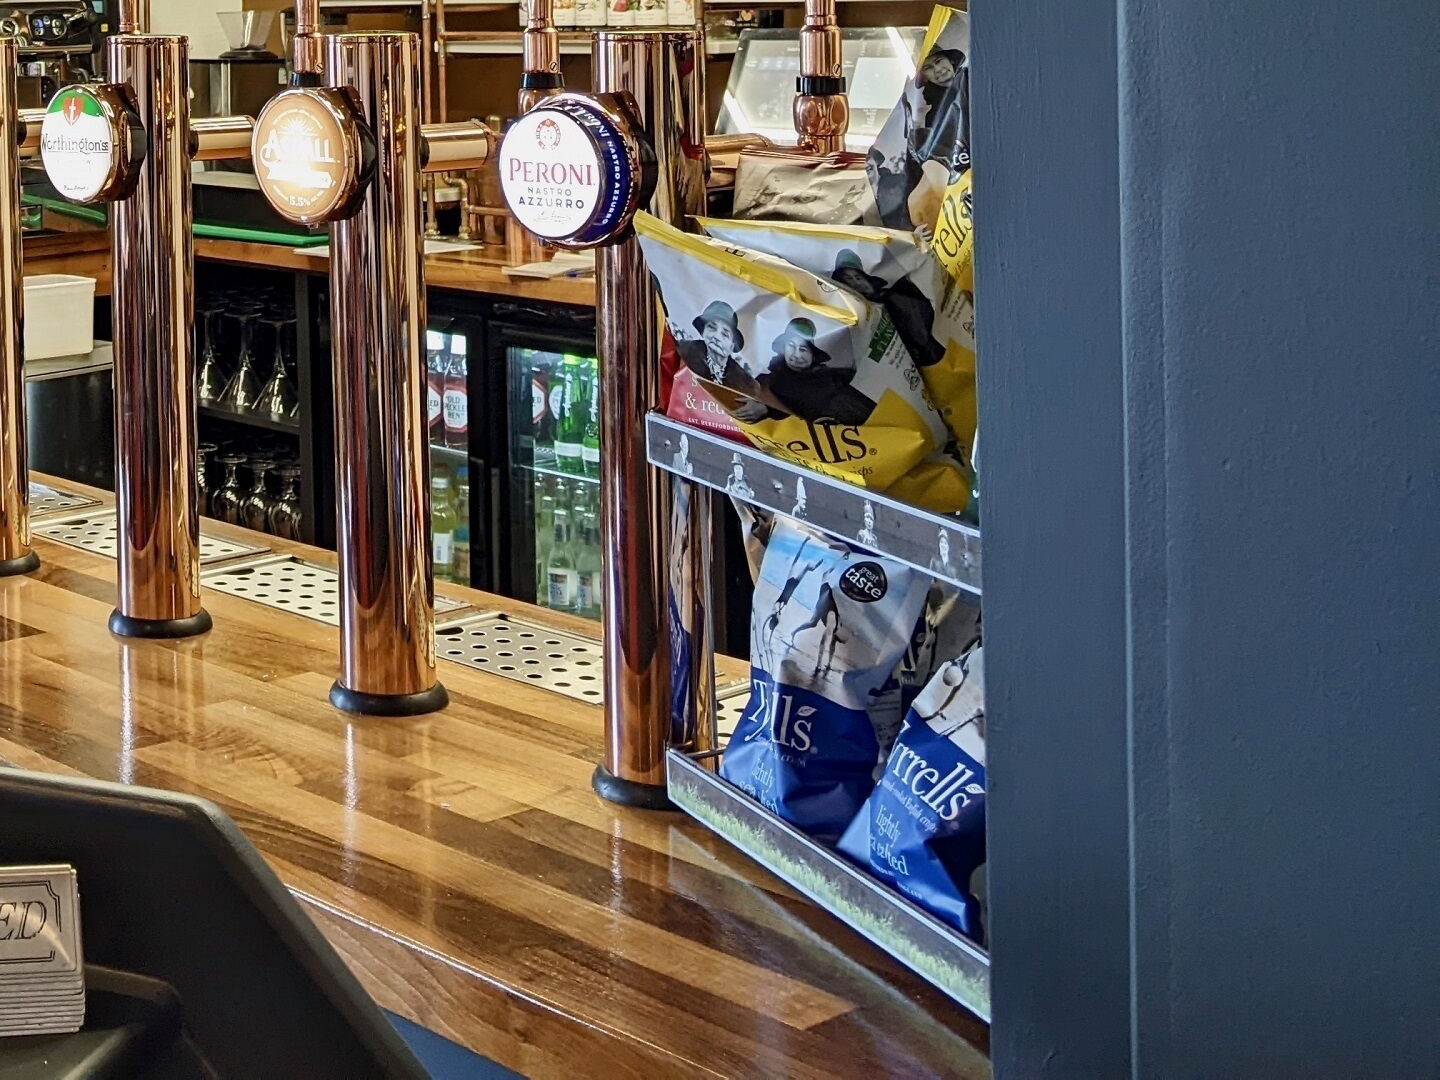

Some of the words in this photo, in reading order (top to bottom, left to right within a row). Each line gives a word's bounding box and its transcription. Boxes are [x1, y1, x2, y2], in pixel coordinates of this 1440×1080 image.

[509, 157, 593, 187] PERONI
[518, 196, 585, 210] AZZURRO
[527, 186, 572, 197] NASTRO
[845, 568, 882, 599] taste
[875, 804, 902, 848] lightly
